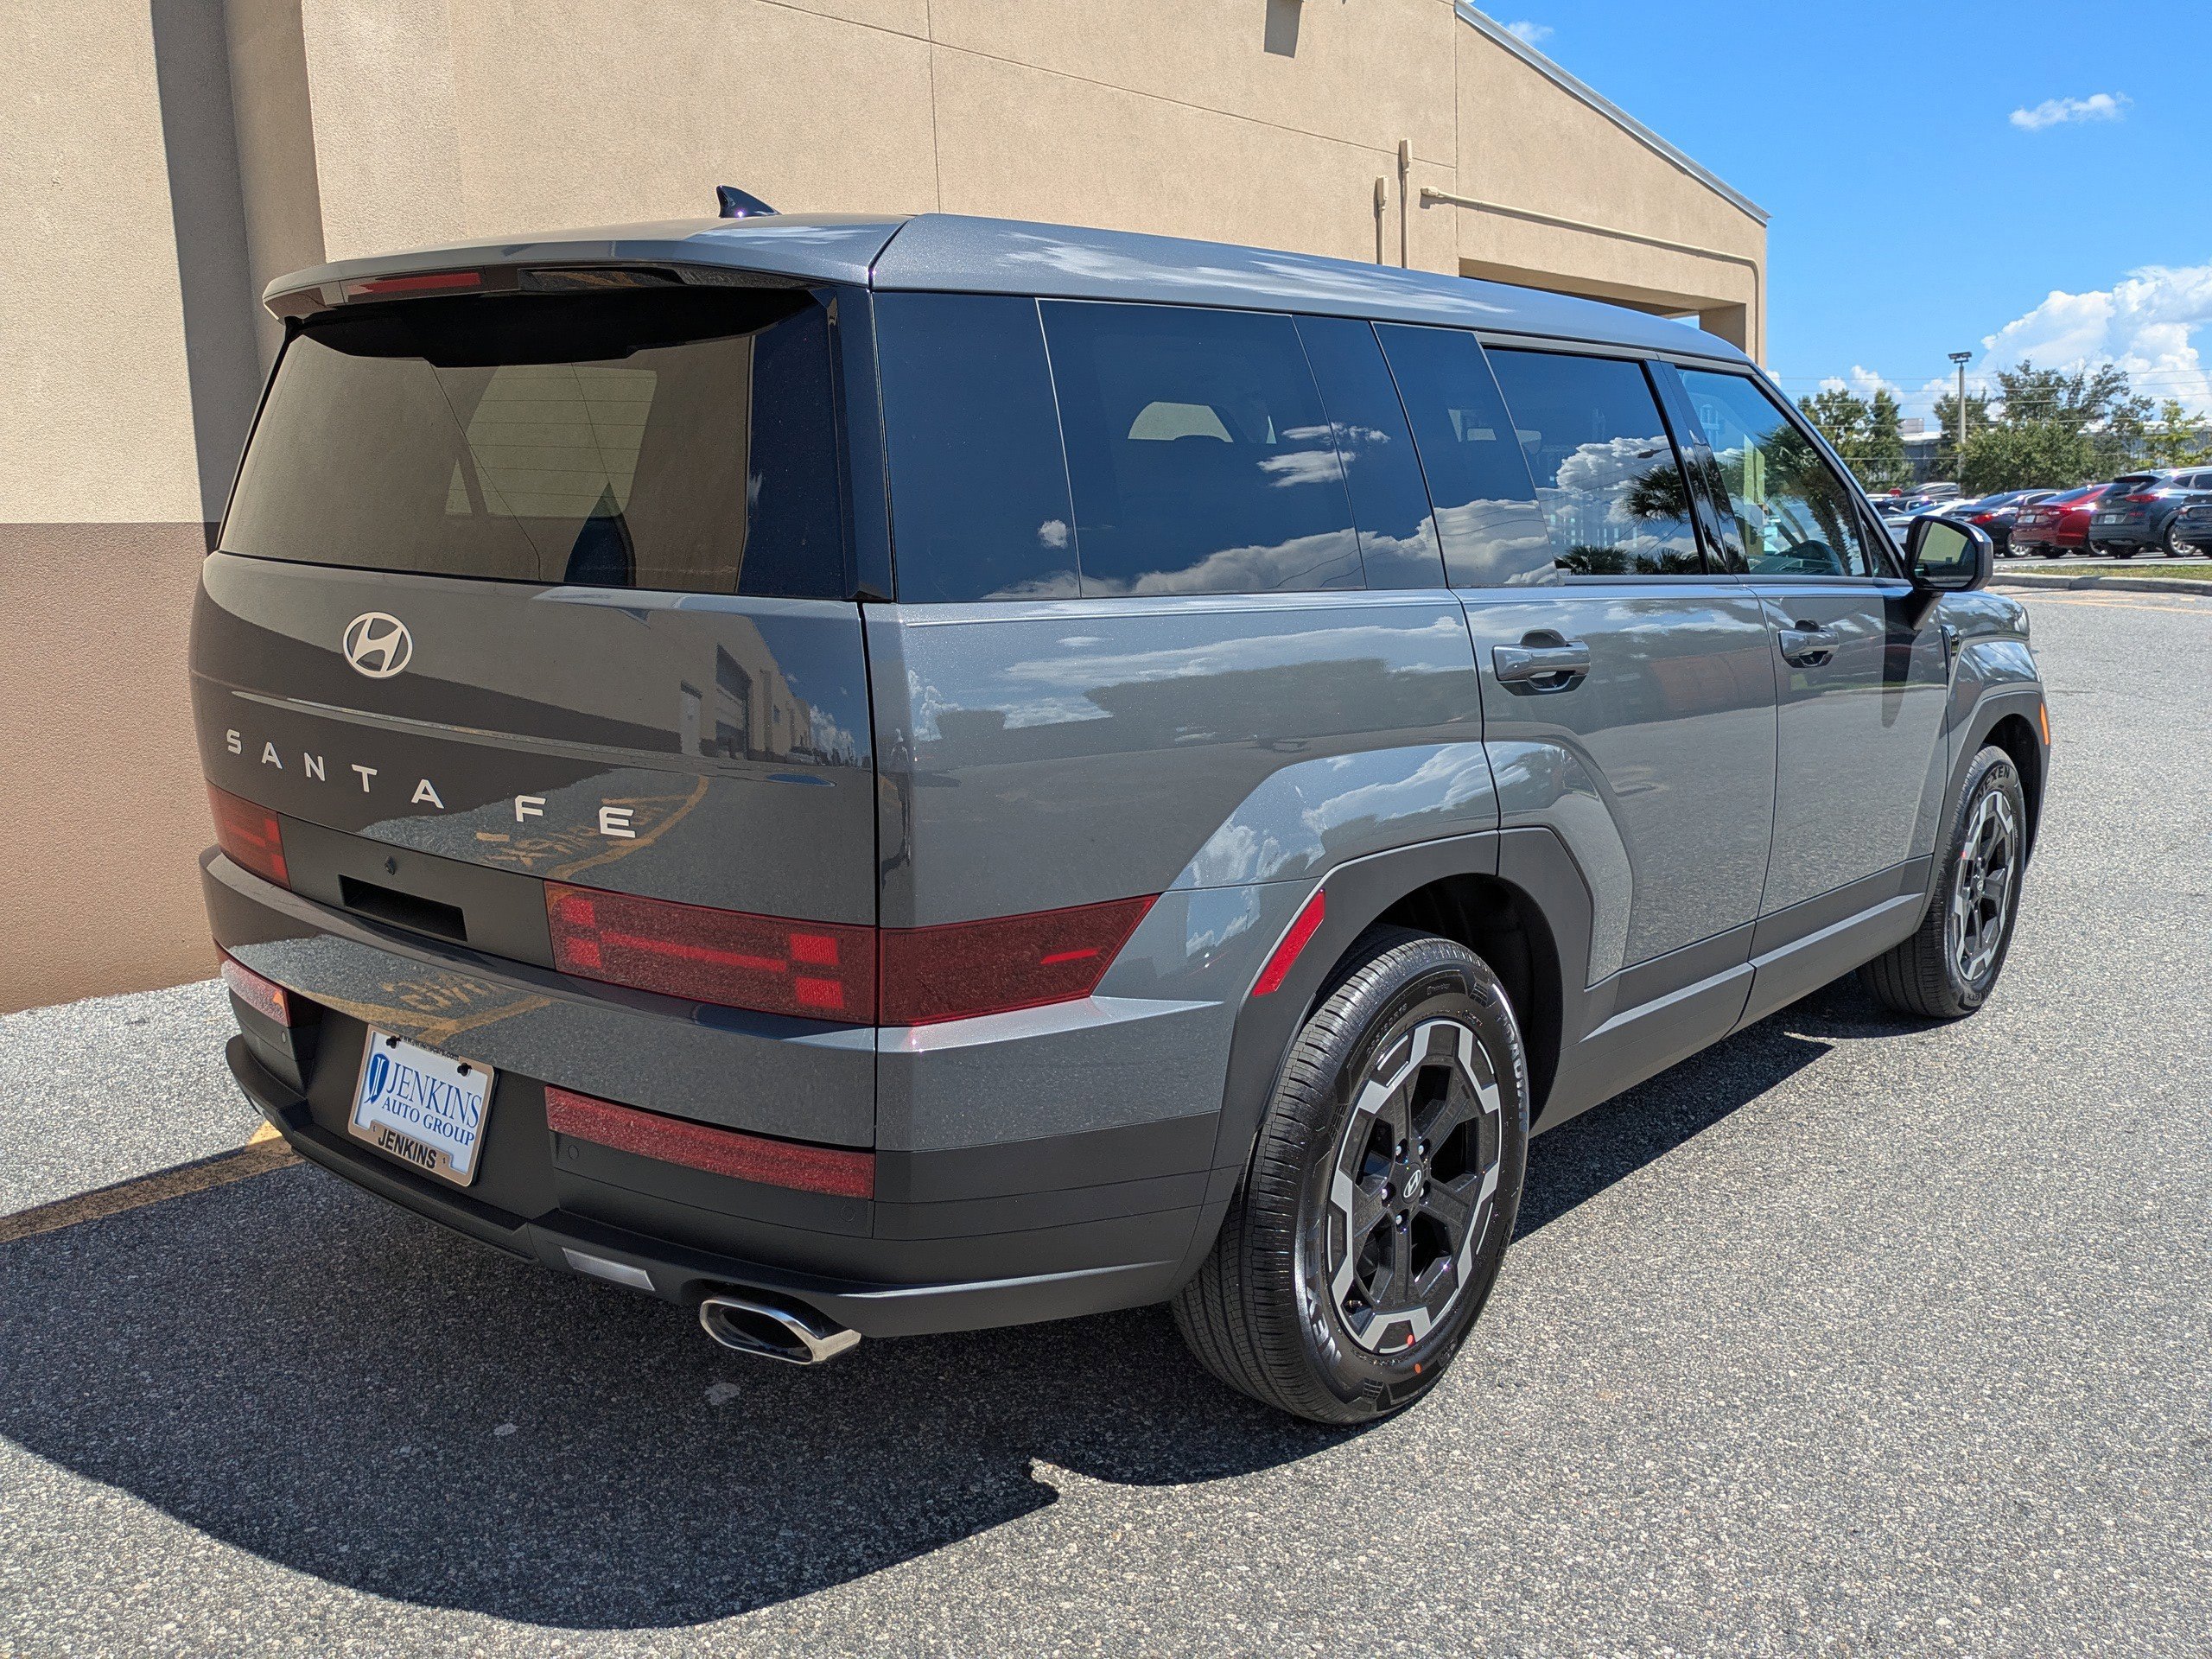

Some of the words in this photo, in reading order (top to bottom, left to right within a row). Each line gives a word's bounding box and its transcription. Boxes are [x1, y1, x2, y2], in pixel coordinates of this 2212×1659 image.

[226, 728, 444, 809] SANTA
[514, 794, 636, 838] FE
[1975, 765, 2010, 802] NEXEN
[385, 1062, 482, 1128] JENKINS
[381, 1096, 420, 1123] AUTO
[423, 1114, 475, 1147] GROUP
[378, 1128, 437, 1169] JENKINS
